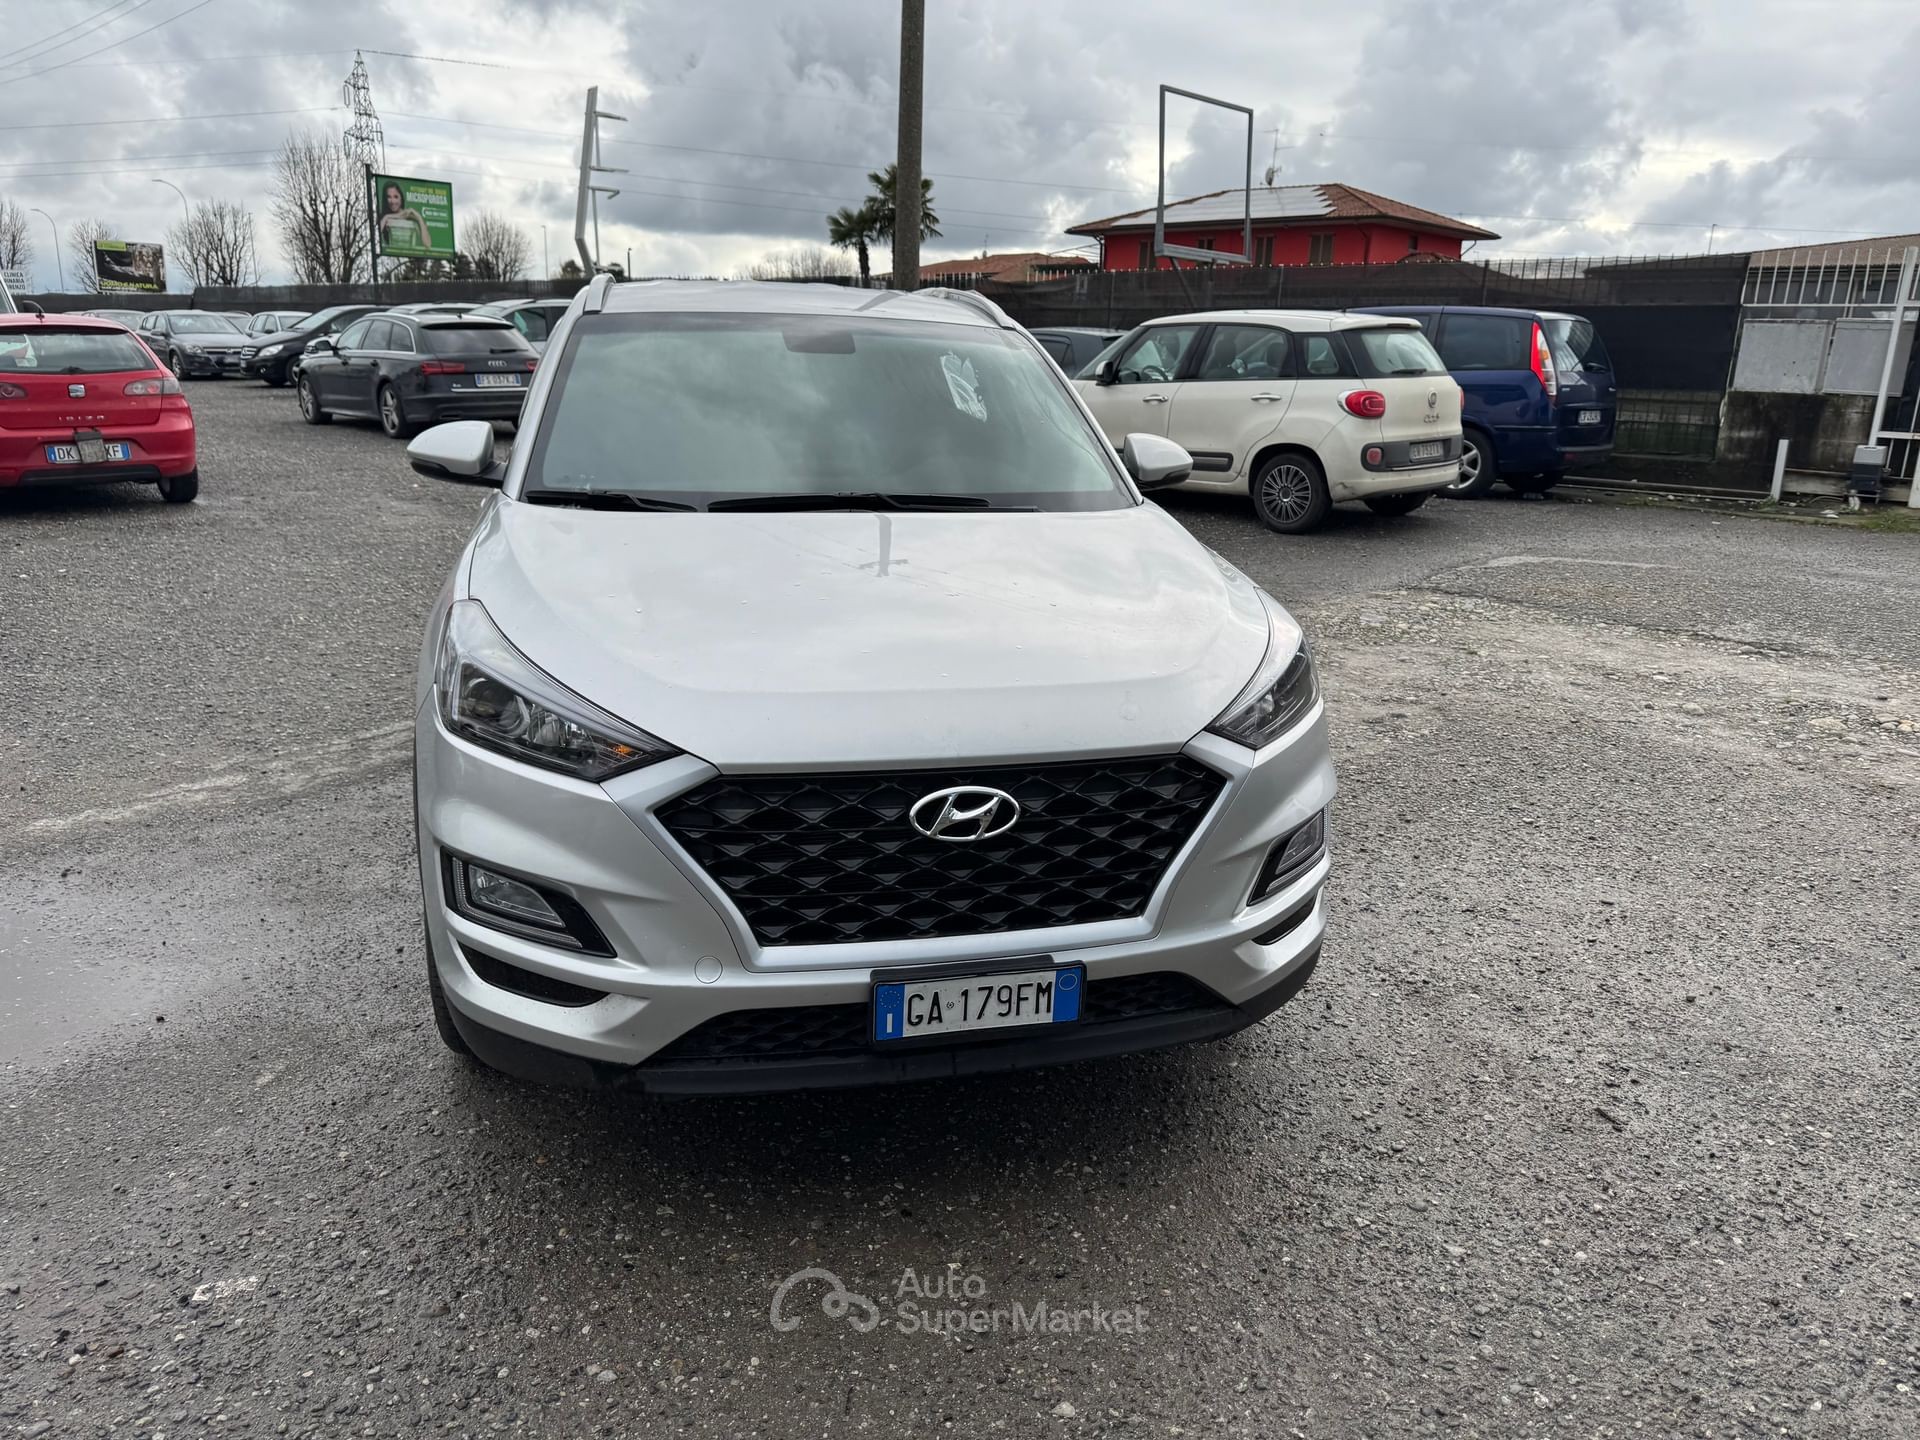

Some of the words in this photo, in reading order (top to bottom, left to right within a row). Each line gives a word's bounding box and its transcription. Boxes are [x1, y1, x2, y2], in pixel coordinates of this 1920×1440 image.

[57, 447, 75, 460] DK
[907, 991, 943, 1026] GA
[960, 981, 1053, 1022] 179FM
